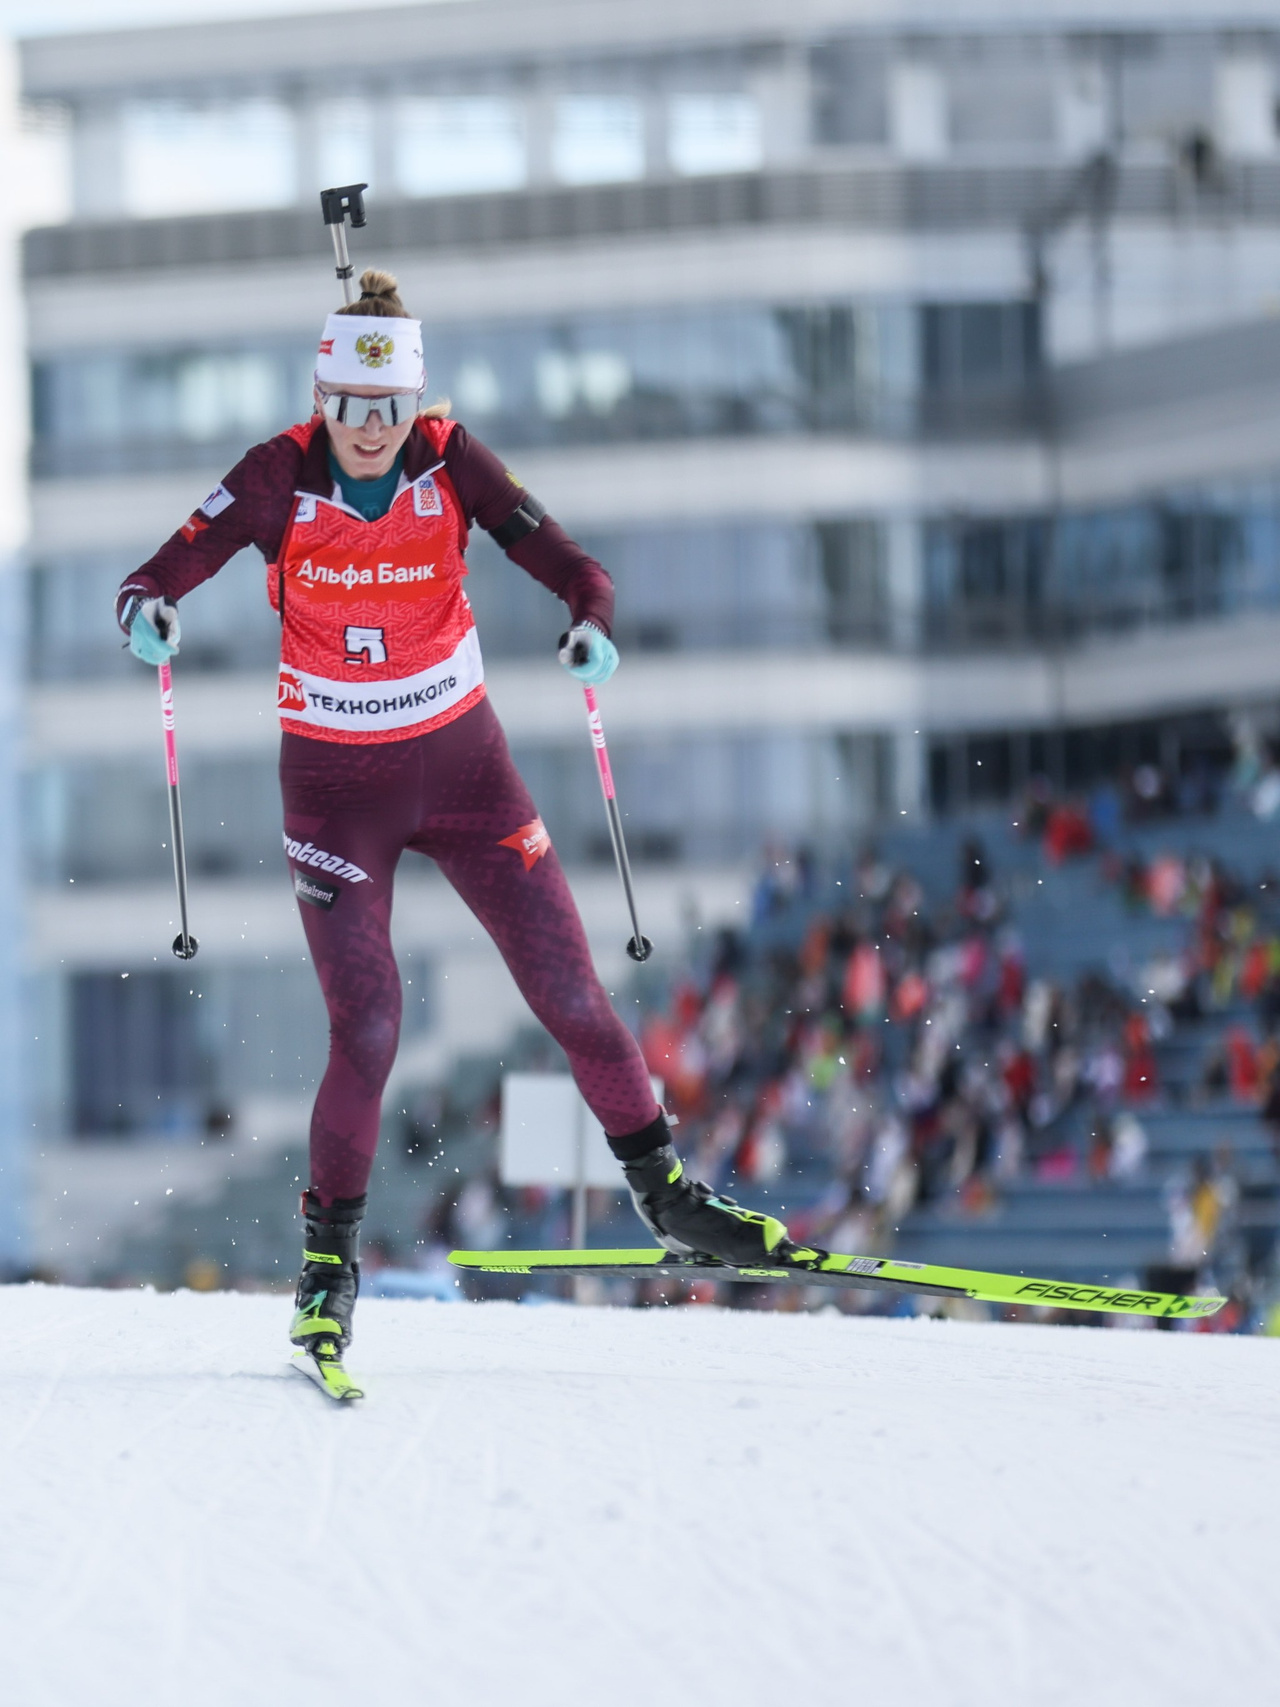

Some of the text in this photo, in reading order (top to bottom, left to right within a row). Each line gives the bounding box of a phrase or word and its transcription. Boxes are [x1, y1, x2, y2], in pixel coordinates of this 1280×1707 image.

[296, 558, 436, 590] Альфа Банк
[343, 625, 388, 665] 5
[308, 674, 457, 715] ТЕХНОНИКОЛЬ
[282, 831, 368, 884] roteam
[738, 1268, 790, 1278] FISCHER
[1015, 1282, 1163, 1310] FISCHER
